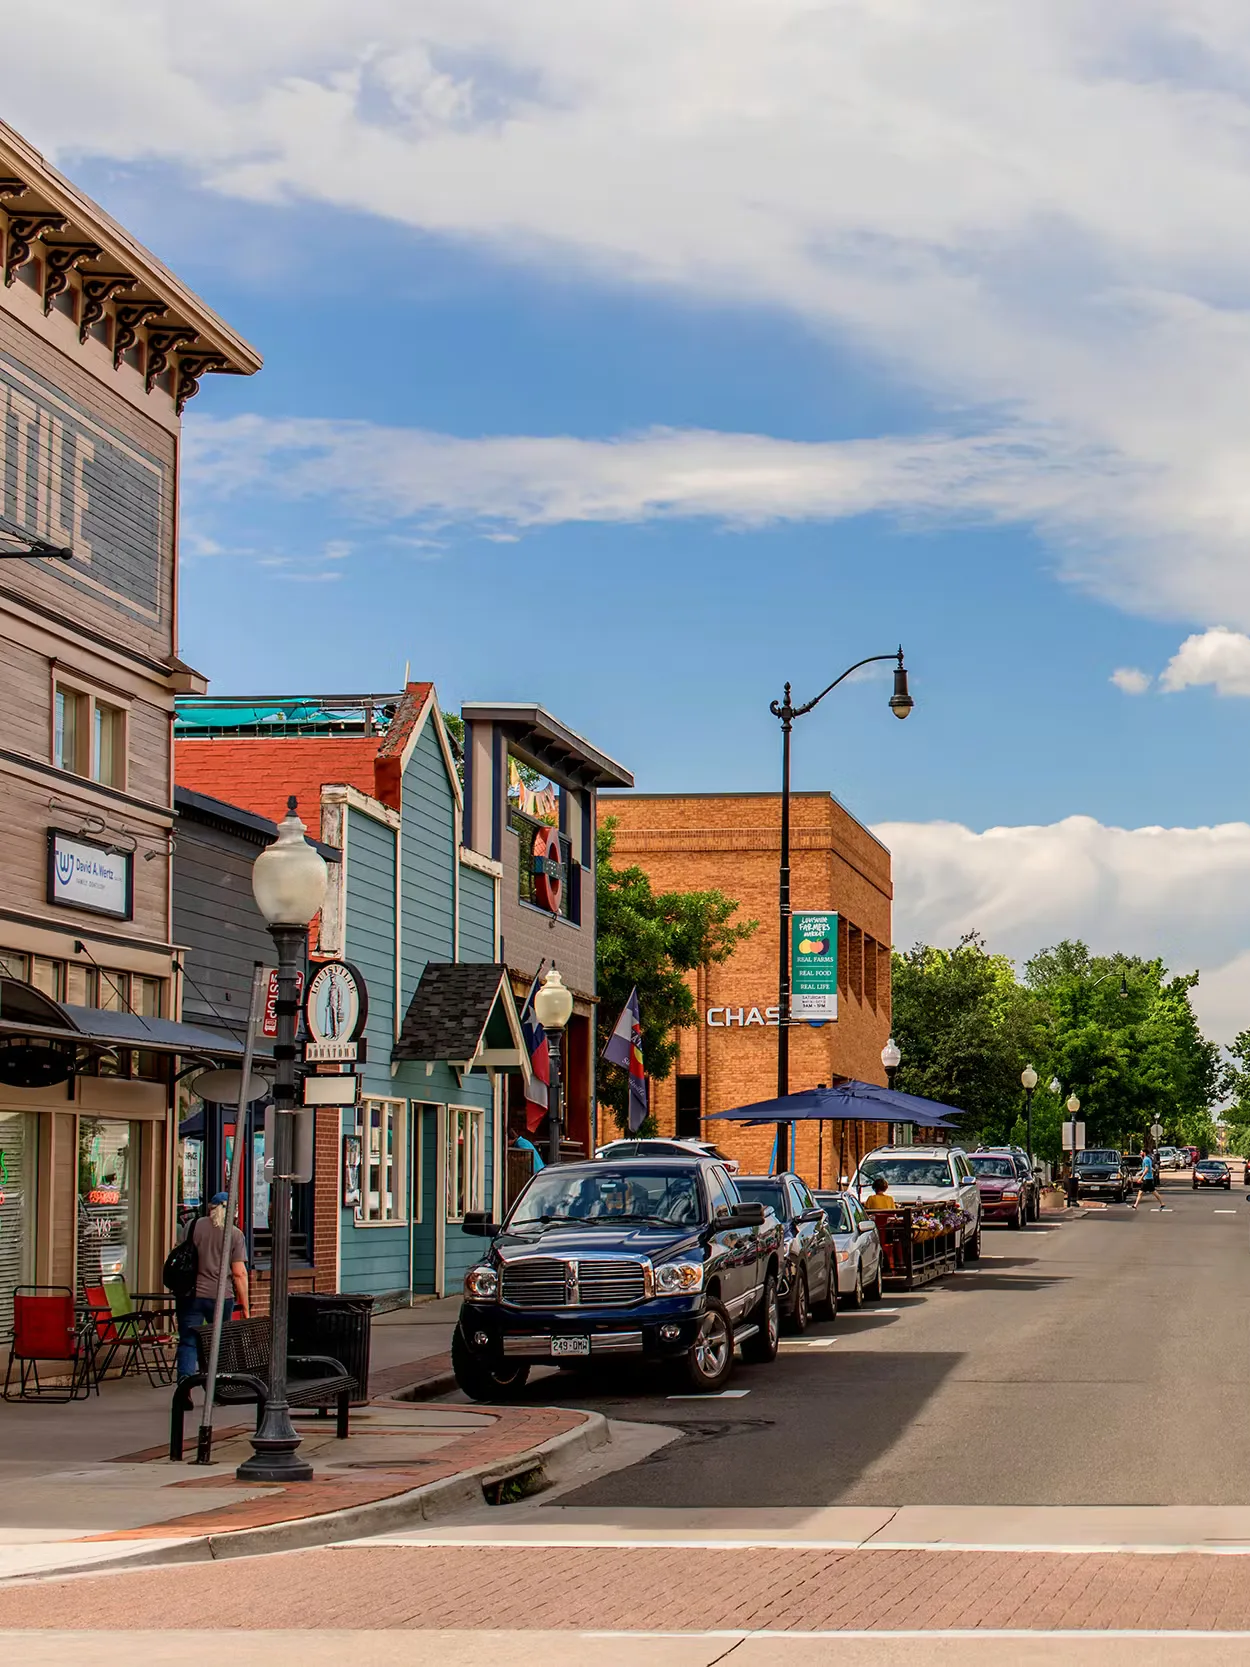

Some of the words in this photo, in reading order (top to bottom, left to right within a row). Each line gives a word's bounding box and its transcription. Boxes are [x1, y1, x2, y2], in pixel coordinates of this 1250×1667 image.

[76, 858, 92, 874] David
[100, 865, 114, 880] Wertz
[799, 924, 831, 932] FARMERS
[311, 965, 357, 995] LOUISVILLE
[707, 1007, 779, 1026] CHAS
